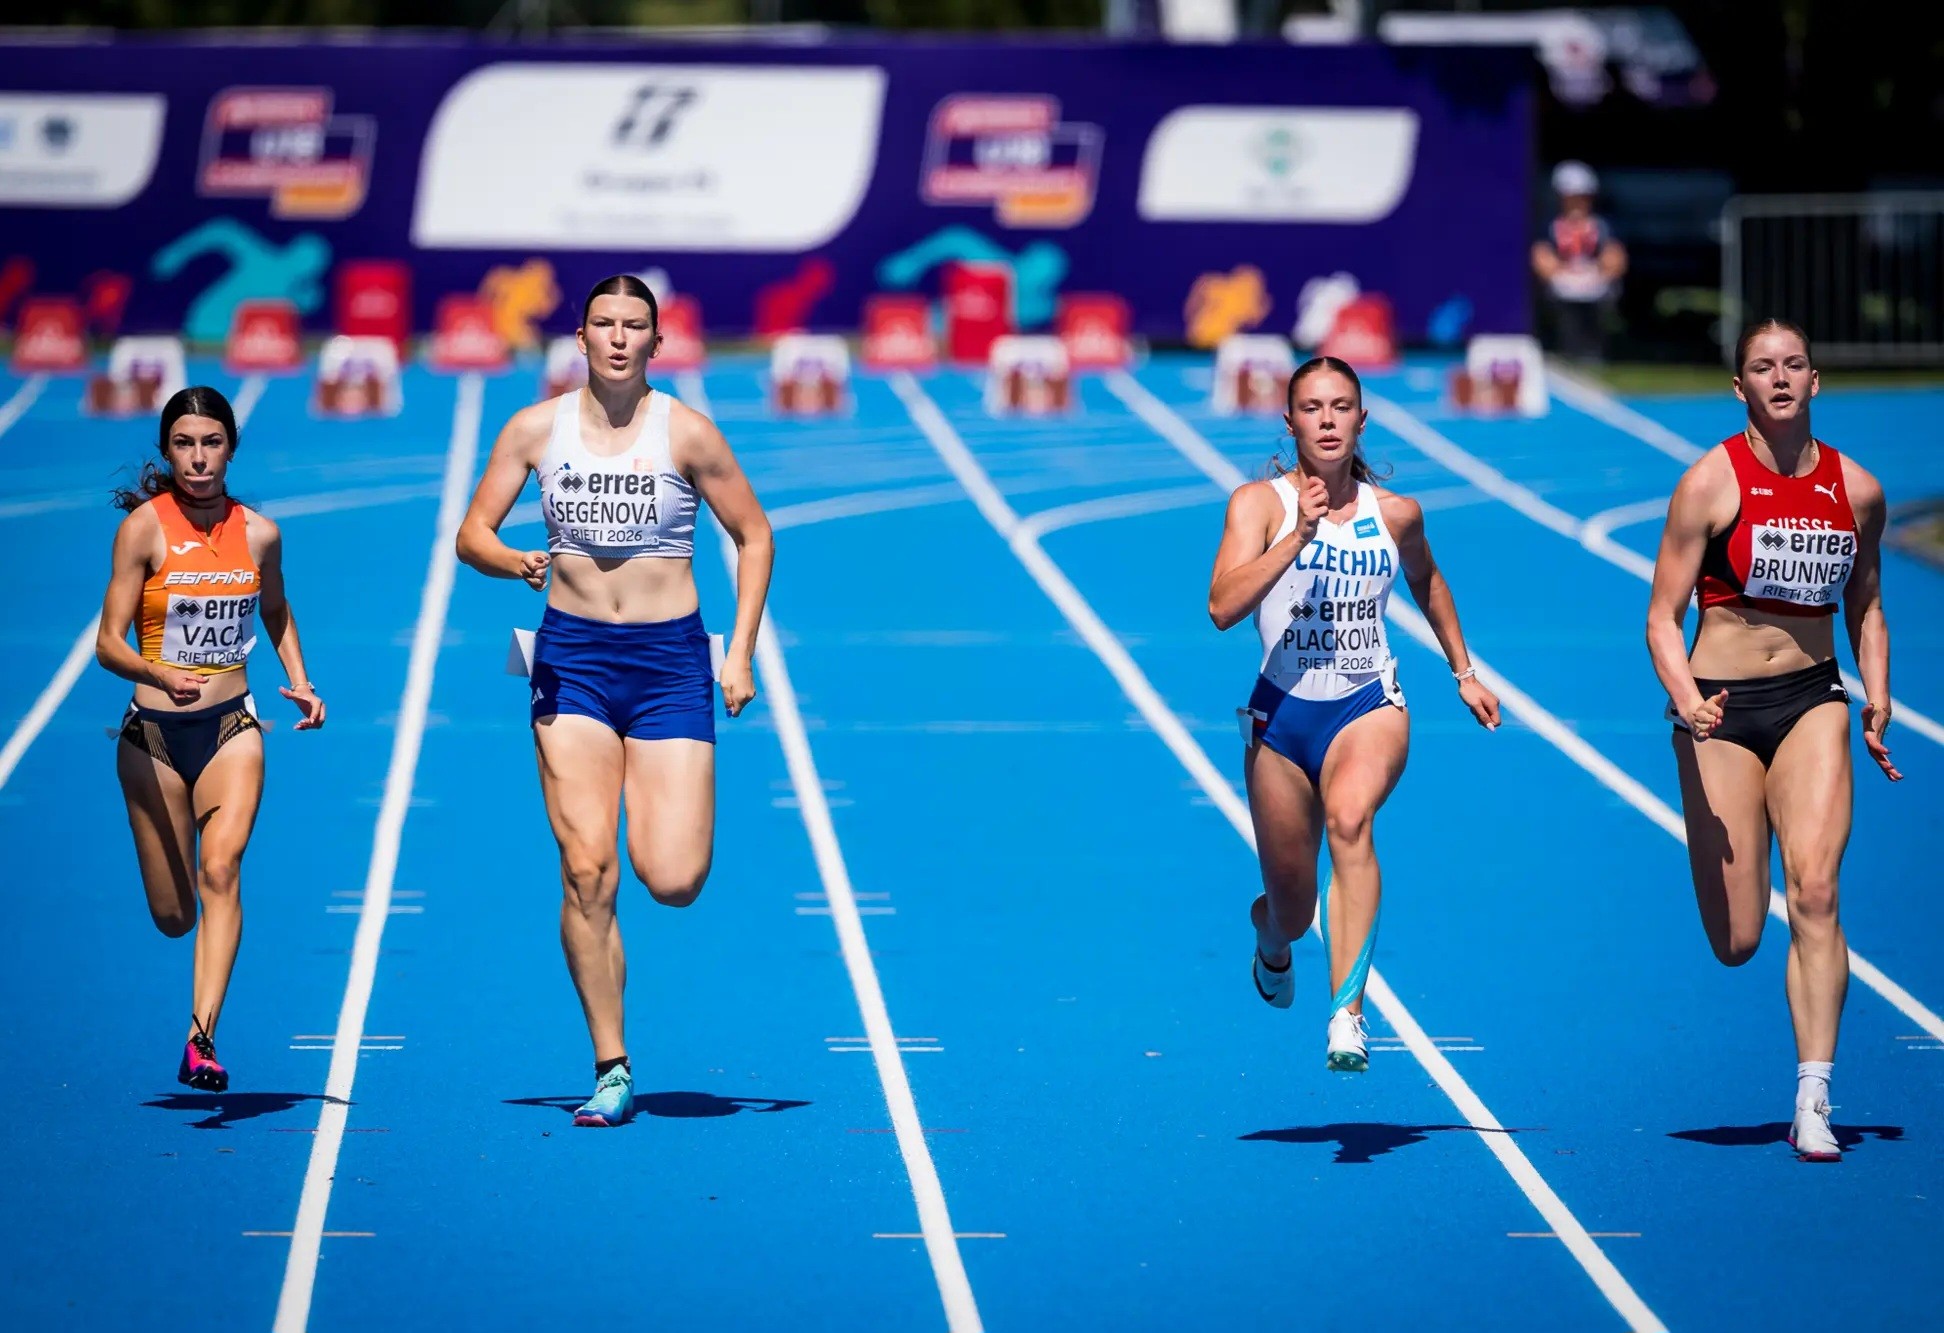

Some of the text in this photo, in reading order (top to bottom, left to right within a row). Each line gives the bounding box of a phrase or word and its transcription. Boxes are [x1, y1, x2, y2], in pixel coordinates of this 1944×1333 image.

[556, 495, 658, 525] SEGÉNOVÁ
[571, 528, 642, 542] RIETI 2026
[1295, 540, 1392, 578] CZECHIA
[165, 569, 255, 586] ESPAÑA
[1752, 558, 1850, 585] BRUNNER
[1762, 585, 1831, 603] RIETI 2026
[181, 624, 244, 647] VACA
[1284, 619, 1381, 651] PLACKOVÁ
[177, 649, 247, 664] RIETI 2026
[1298, 656, 1374, 670] RIETI 2026
